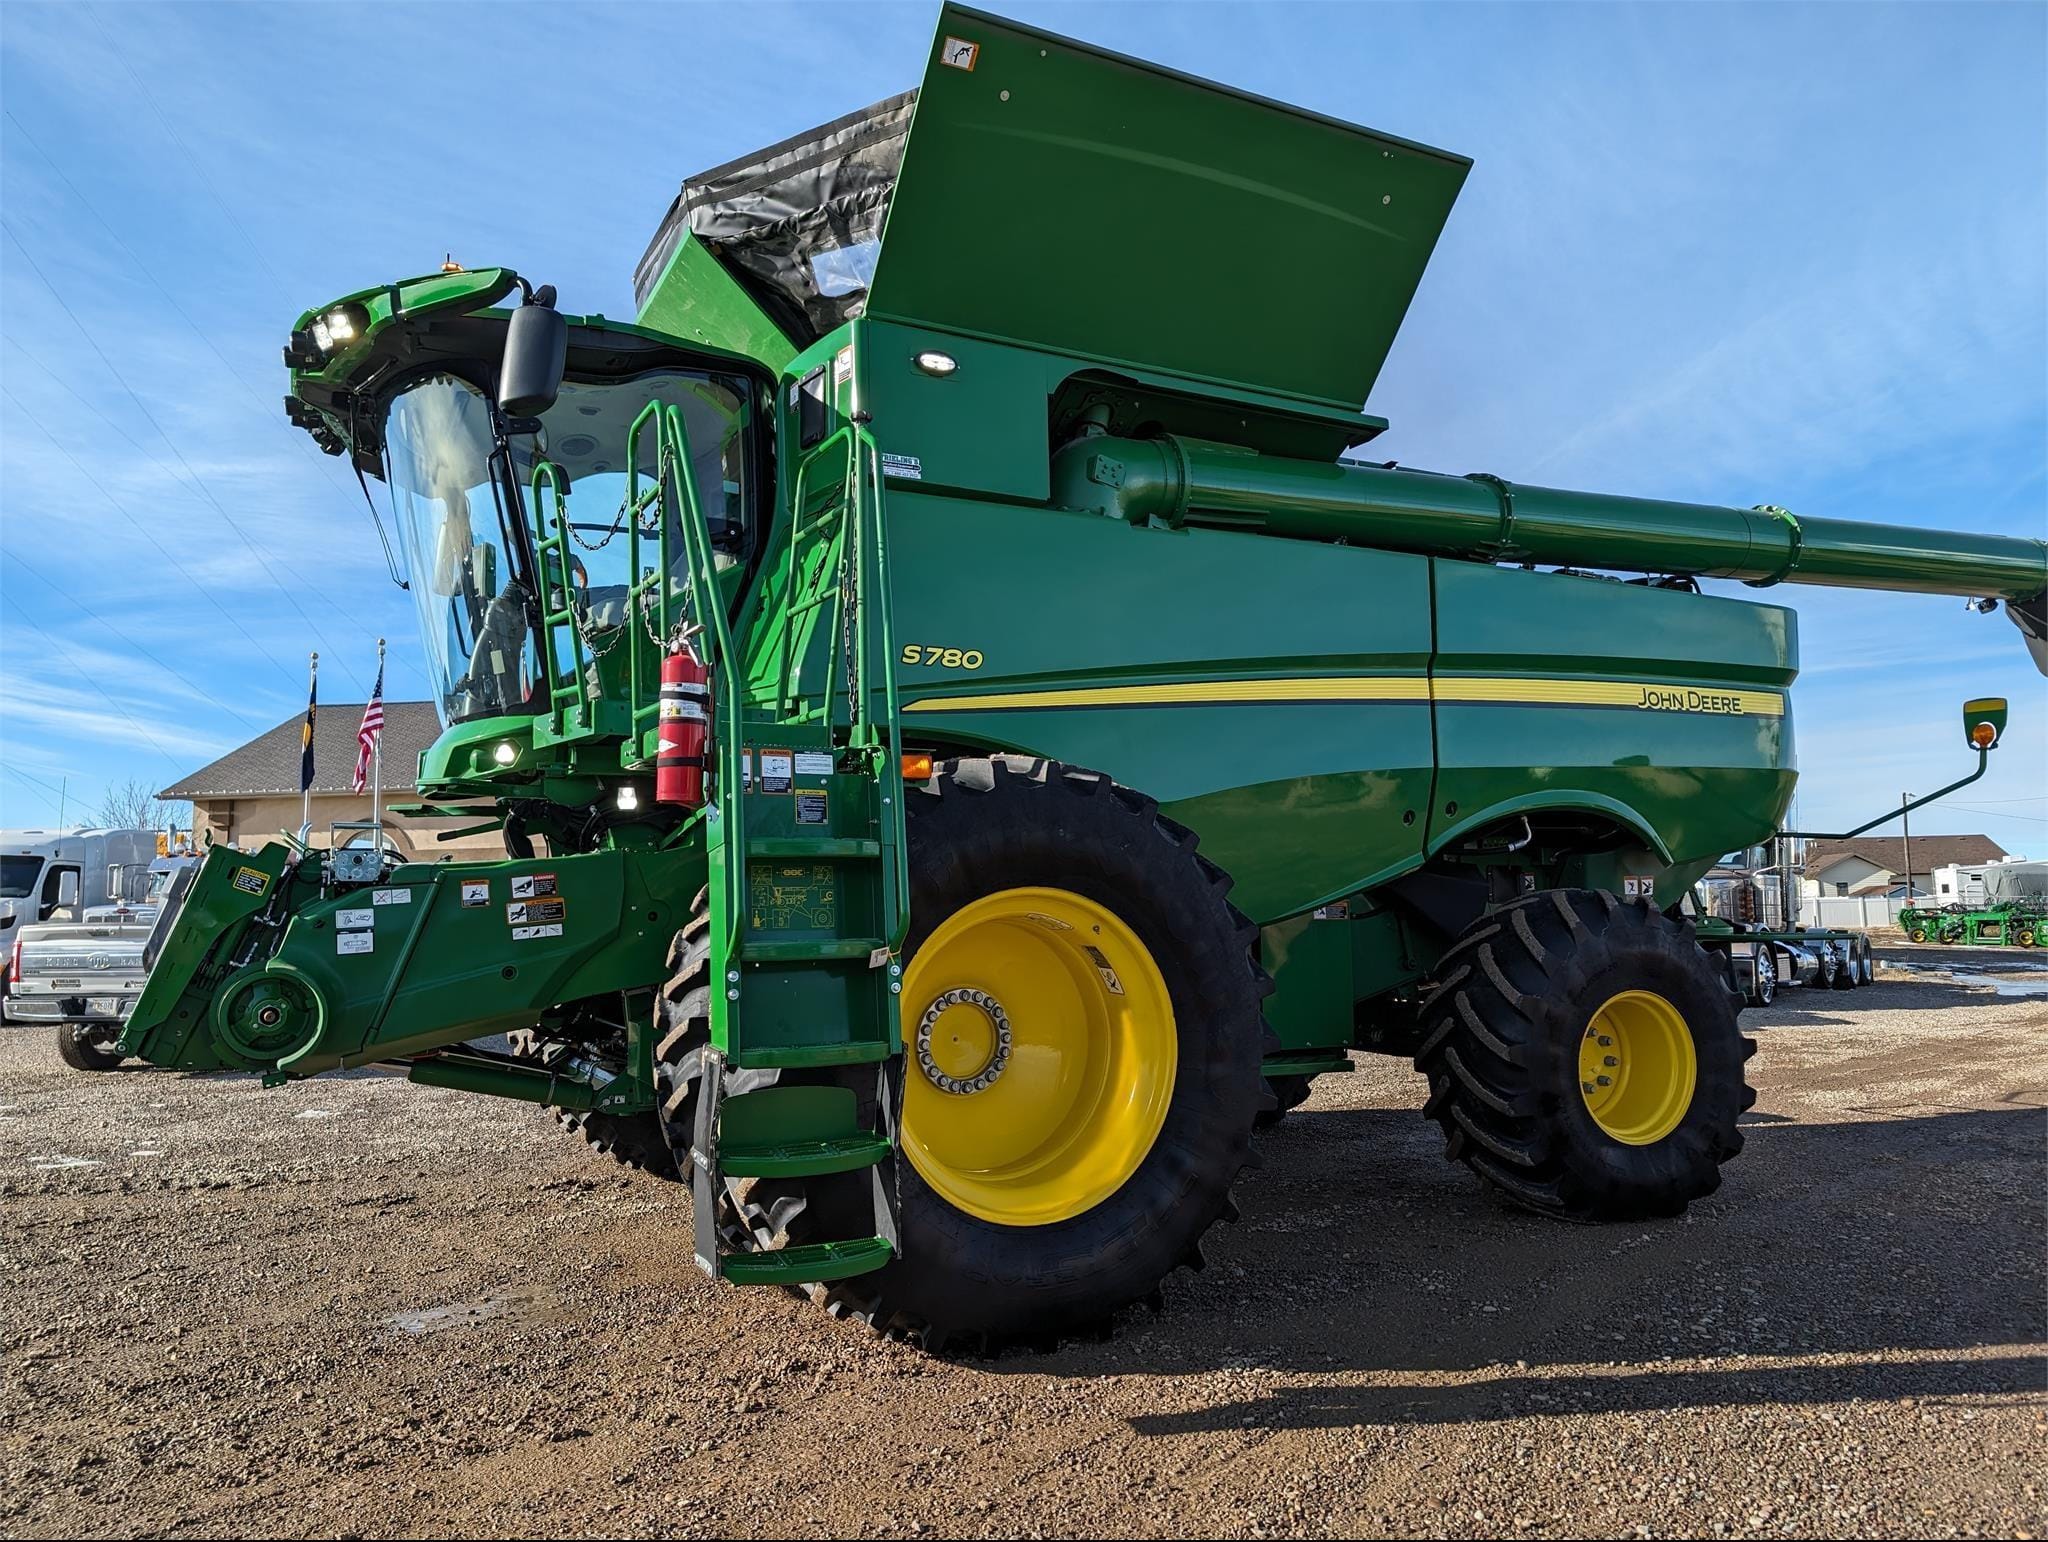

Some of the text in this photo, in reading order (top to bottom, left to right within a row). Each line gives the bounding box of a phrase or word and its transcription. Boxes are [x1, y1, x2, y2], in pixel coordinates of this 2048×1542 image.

[901, 644, 984, 670] S780
[1637, 687, 1744, 713] JOHN DEERE
